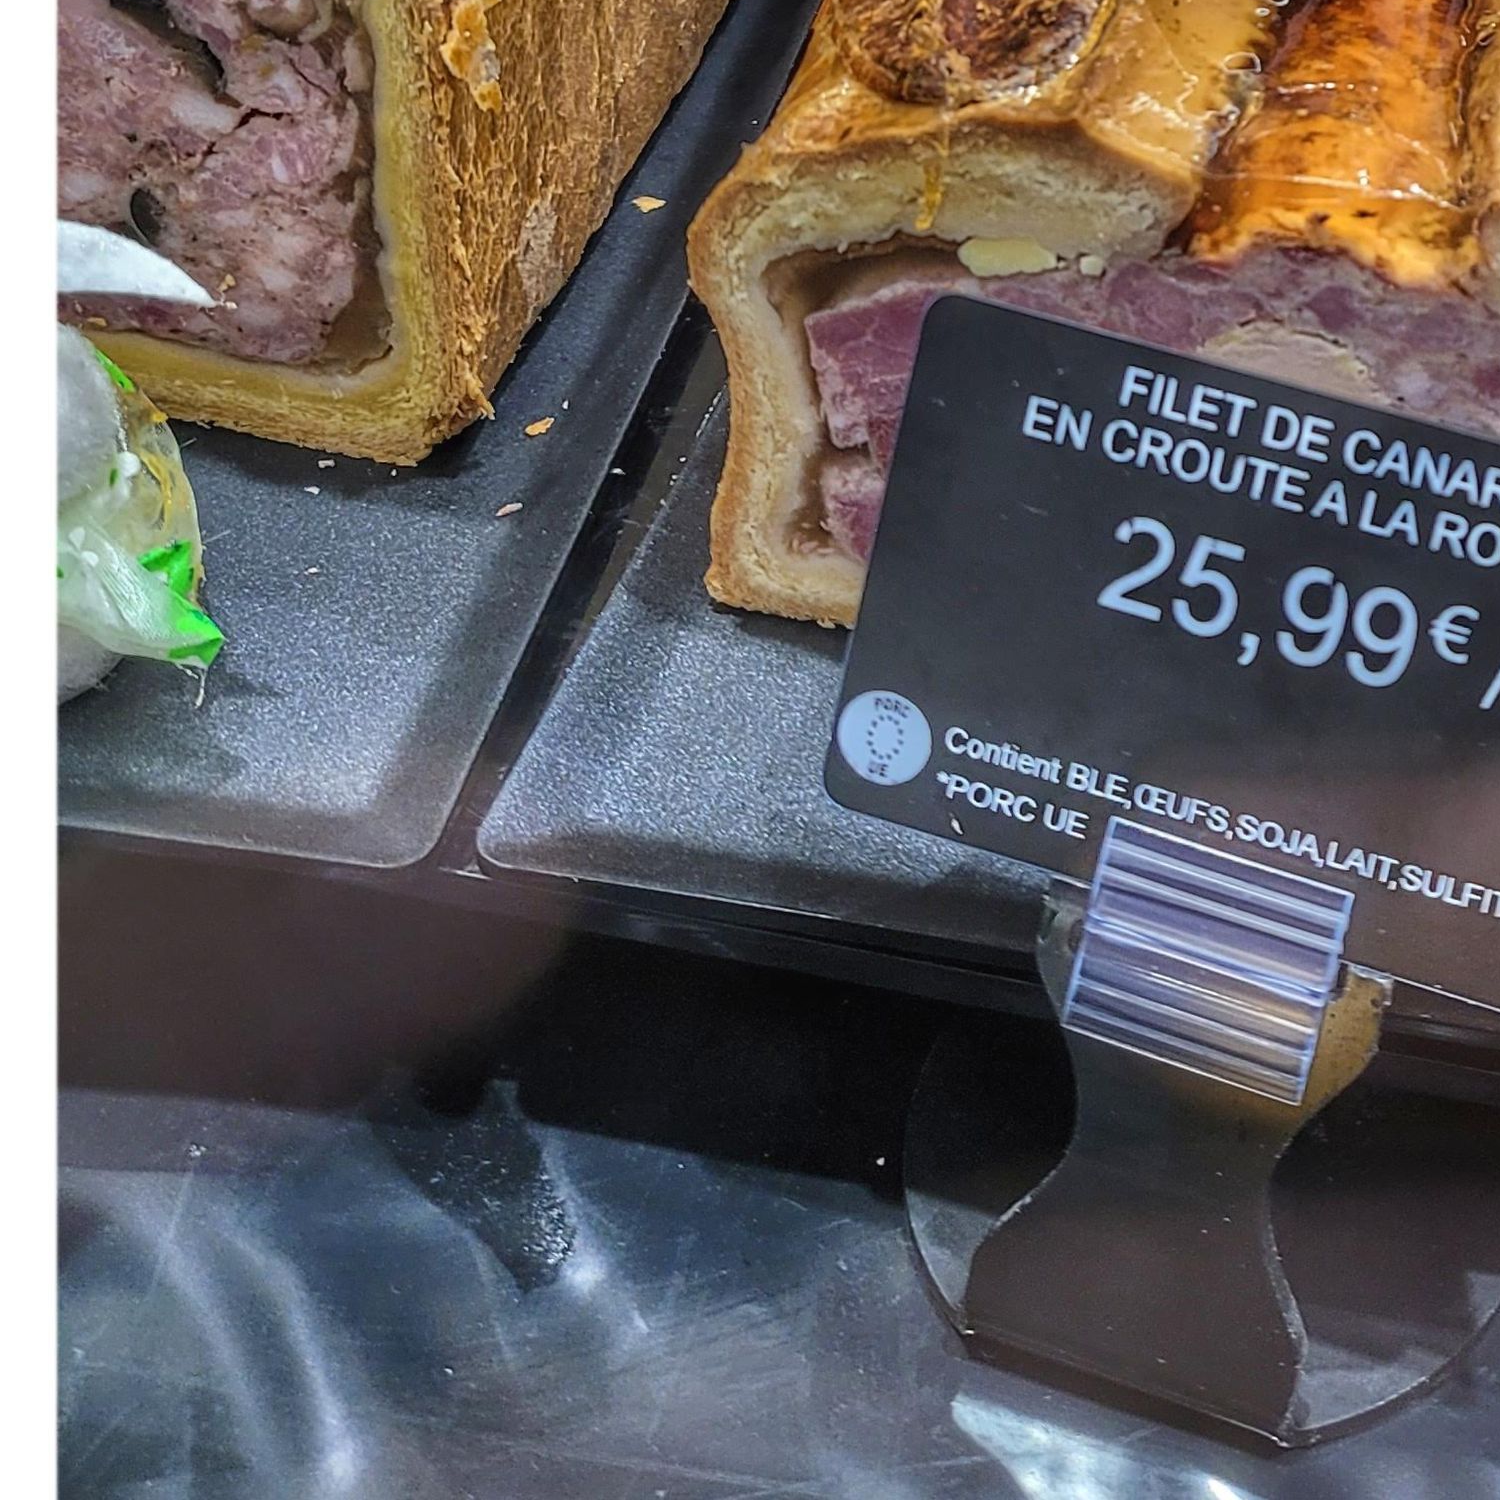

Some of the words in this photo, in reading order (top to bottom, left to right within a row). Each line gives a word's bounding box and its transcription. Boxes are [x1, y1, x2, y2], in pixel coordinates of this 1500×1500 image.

[1117, 365, 1258, 438] FILET
[1261, 405, 1335, 463] DE
[1021, 395, 1093, 452] EN
[1101, 419, 1311, 512] CROUTE
[1309, 480, 1349, 526] A
[1358, 490, 1420, 547] LA
[944, 726, 1064, 784] Contient
[1043, 803, 1090, 840] UE
